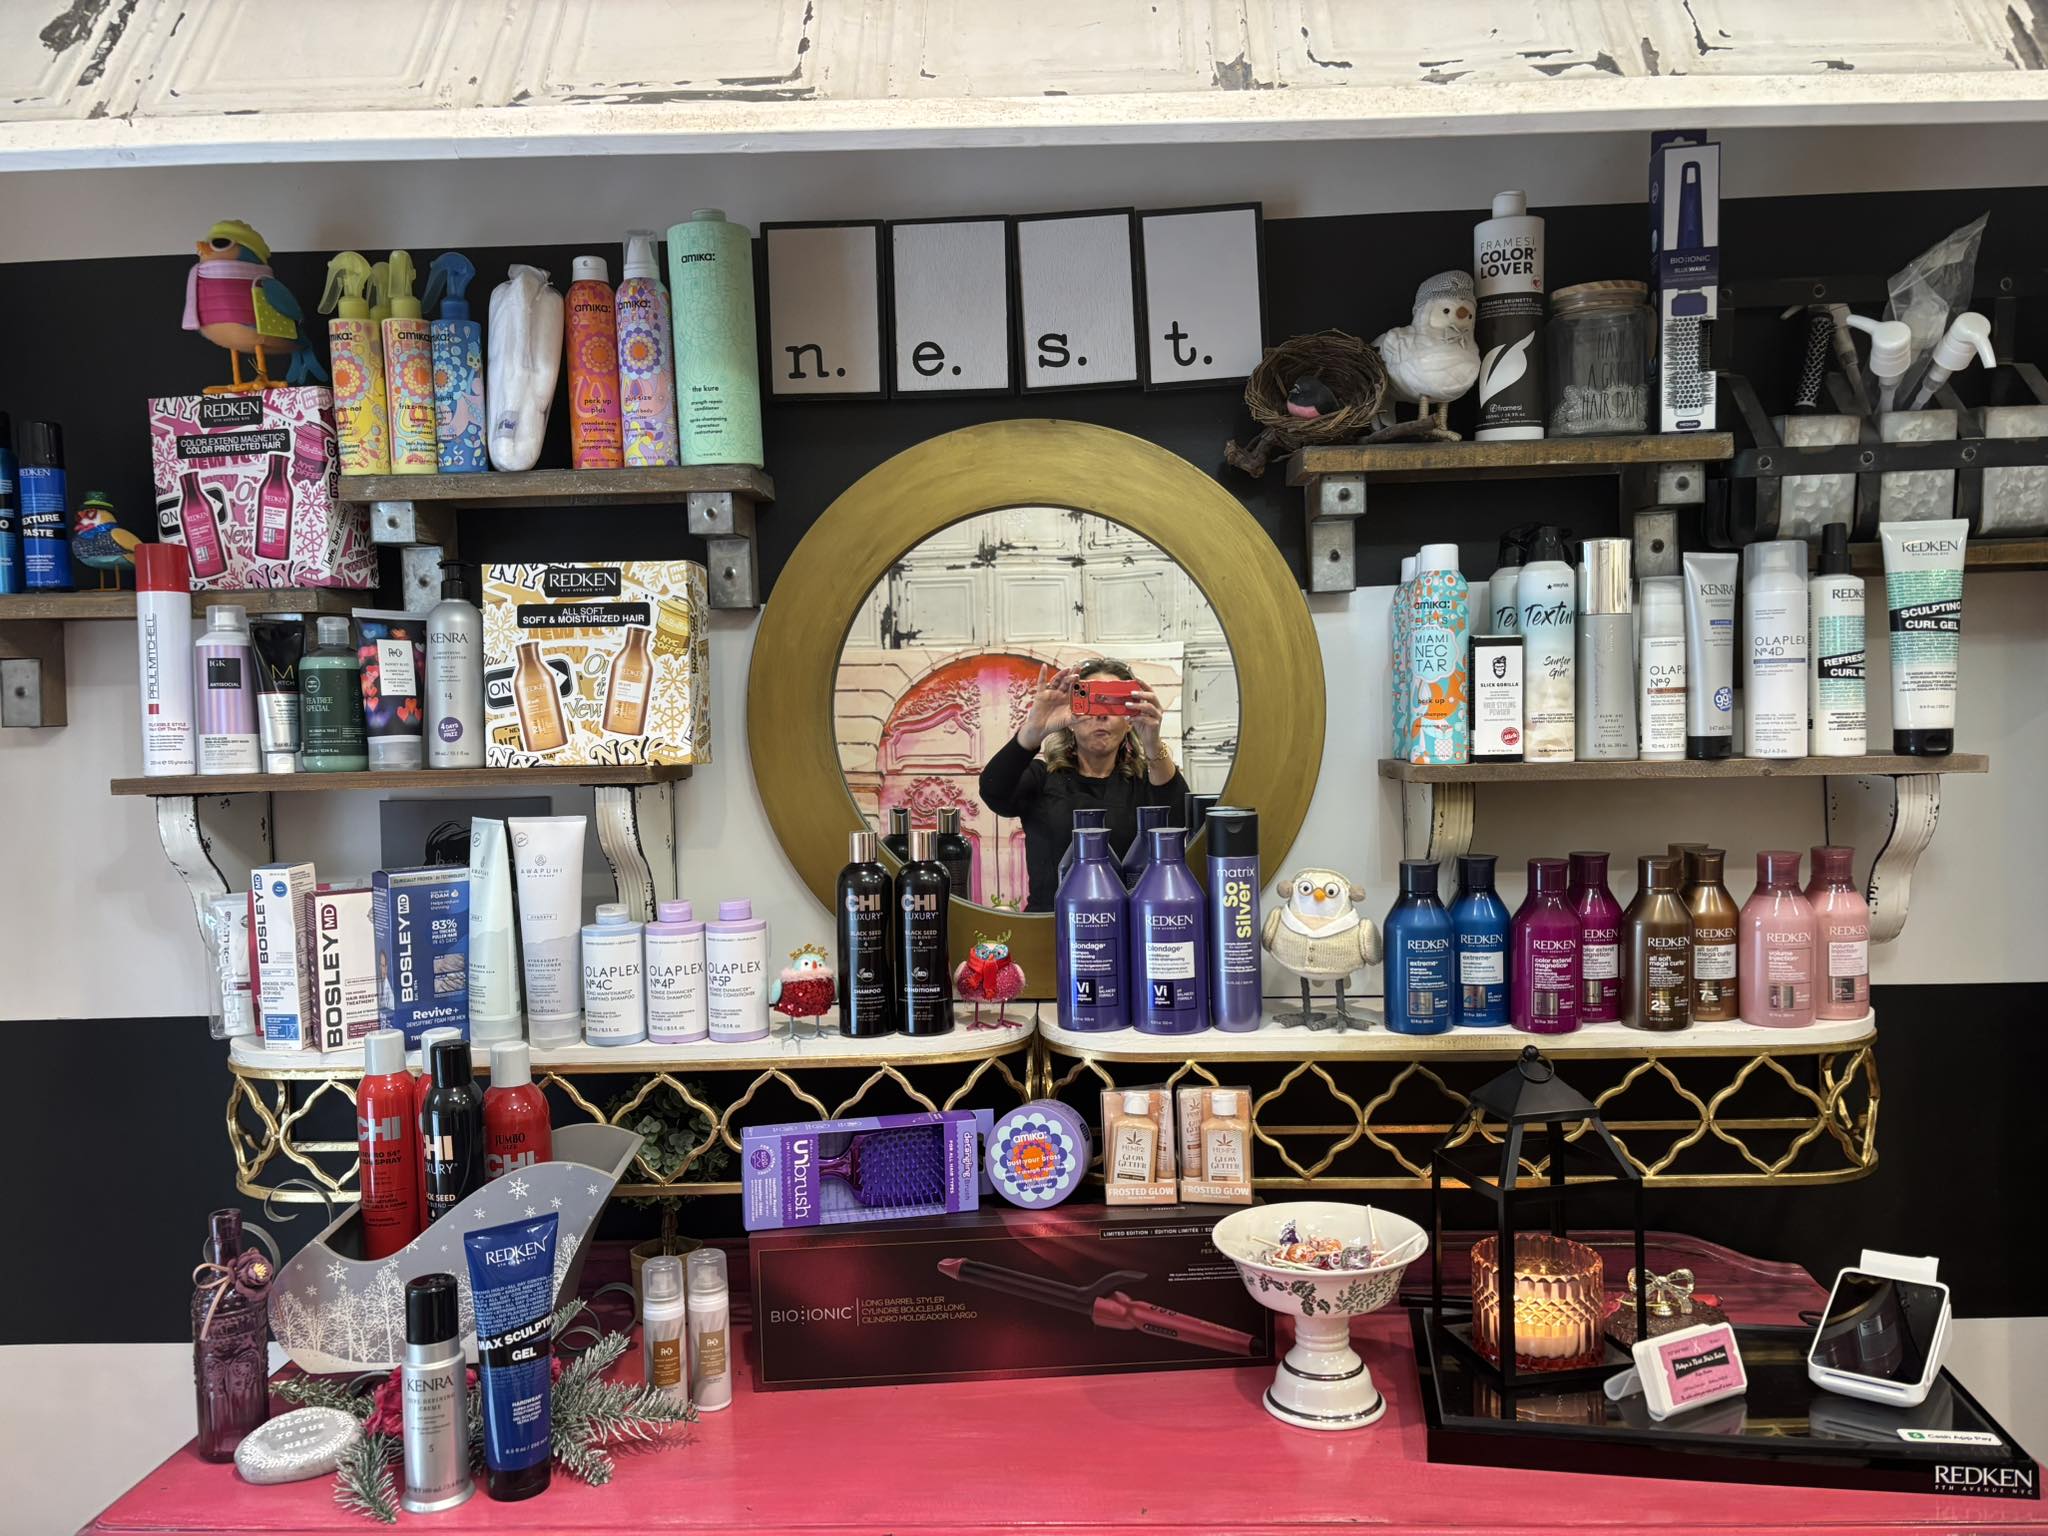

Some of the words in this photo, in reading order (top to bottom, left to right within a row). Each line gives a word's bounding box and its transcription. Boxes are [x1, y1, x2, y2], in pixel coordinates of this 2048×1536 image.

[1480, 237, 1535, 251] FRAMESI
[1480, 247, 1535, 265] COLOR
[1480, 262, 1534, 279] LOVER
[203, 401, 260, 418] REDKEN
[181, 438, 207, 448] COLOR
[208, 436, 239, 446] EXTEND
[240, 433, 286, 443] MAGNETICS
[186, 445, 213, 455] COLOR
[214, 443, 260, 453] PROTECTED
[262, 441, 282, 450] HAIR
[22, 513, 61, 526] EXTURE
[1901, 540, 1958, 553] REDKEN
[550, 572, 617, 588] REDKEN
[1832, 588, 1865, 600] REDKE
[562, 607, 580, 616] ALL
[582, 606, 605, 615] SOFT
[1901, 600, 1961, 619] SCULPTING
[522, 615, 547, 624] SOFT
[549, 615, 556, 624] &
[557, 614, 620, 624] MOISTURIZED
[622, 613, 645, 623] HAIR
[1905, 620, 1938, 630] CURL
[1939, 620, 1959, 630] GEL
[430, 632, 468, 644] KENRA
[1415, 634, 1449, 644] MIAMI
[1415, 644, 1448, 659] NEC
[1415, 658, 1448, 673] TAR
[1830, 667, 1858, 678] CURL
[1216, 866, 1255, 878] matrix
[253, 873, 263, 890] MD
[398, 895, 410, 914] MD
[845, 893, 881, 912] CHI
[901, 893, 937, 912] CHI
[322, 904, 338, 931] MD
[1068, 912, 1116, 924] REDKEN
[1145, 914, 1193, 927] REDKEN
[254, 891, 269, 965] BOSLEY
[432, 919, 458, 931] 83%
[1829, 925, 1867, 936] REDKEN
[1460, 933, 1503, 944] REDKEN
[1584, 928, 1618, 939] EDKEN
[1695, 927, 1736, 939] REDKEN
[1766, 932, 1811, 943] REDKEN
[1408, 938, 1449, 950] REDKEN
[1533, 939, 1576, 950] REDKEN
[1647, 935, 1690, 947] REDKEN
[398, 916, 414, 1003] BOSLEY
[585, 963, 640, 978] OLAPLEX
[649, 962, 704, 977] OLAPLEX
[708, 960, 761, 975] OLAPLEX
[322, 932, 343, 1049] BOSLEY
[1076, 981, 1090, 994] Vi
[1154, 984, 1168, 997] Vi
[357, 1116, 401, 1142] CHI
[495, 1132, 526, 1146] JUMBO
[1012, 1130, 1047, 1144] amika:
[424, 1135, 454, 1161] HI
[486, 1150, 536, 1178] CHI
[1006, 1159, 1022, 1167] bust
[1022, 1157, 1041, 1165] your
[1041, 1154, 1061, 1162] brass
[1108, 1187, 1147, 1196] FROSTED
[1148, 1187, 1174, 1195] GLOW
[1183, 1185, 1222, 1194] FROSTED
[1223, 1185, 1249, 1196] GLOW
[436, 1194, 456, 1202] SEED
[485, 1240, 546, 1266] REDKEN
[862, 1299, 884, 1307] LONG
[884, 1297, 915, 1305] BARREL
[916, 1296, 945, 1304] STYLER
[862, 1306, 900, 1316] CYLINDRE
[900, 1304, 943, 1313] BOUCLEUR
[943, 1303, 966, 1311] LONG
[899, 1313, 949, 1322] MOLDEADOR
[949, 1311, 978, 1320] LARGO
[478, 1337, 504, 1351] MAX
[512, 1346, 537, 1362] GEL
[407, 1375, 454, 1392] KENRA
[1934, 1465, 2033, 1488] REDKEN
